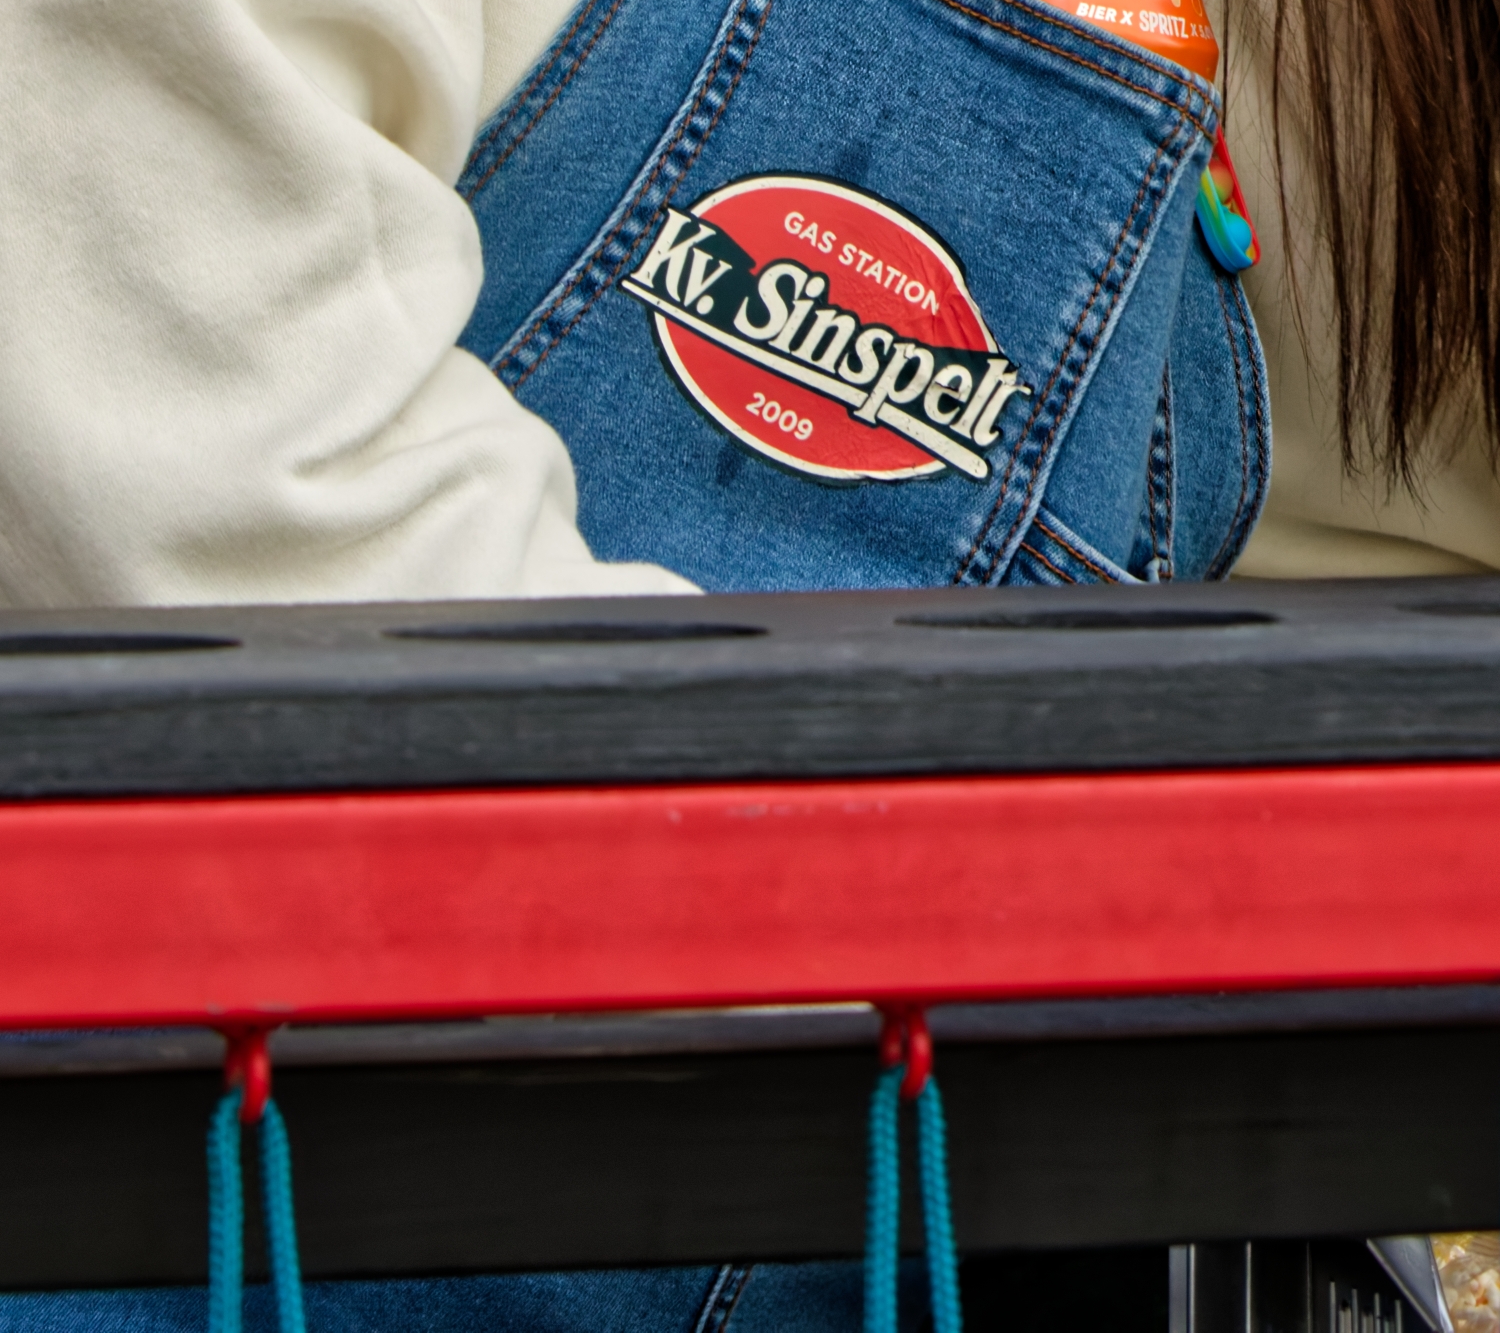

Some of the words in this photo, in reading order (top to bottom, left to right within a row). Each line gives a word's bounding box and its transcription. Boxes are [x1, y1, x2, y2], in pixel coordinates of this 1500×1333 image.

[1076, 2, 1116, 22] BIER
[1139, 10, 1189, 39] SPRITZ
[783, 210, 837, 255] GAS
[838, 241, 941, 318] STATION
[629, 207, 732, 317] Kv.
[734, 259, 1032, 443] Sinspelt
[744, 390, 815, 443] 2009
